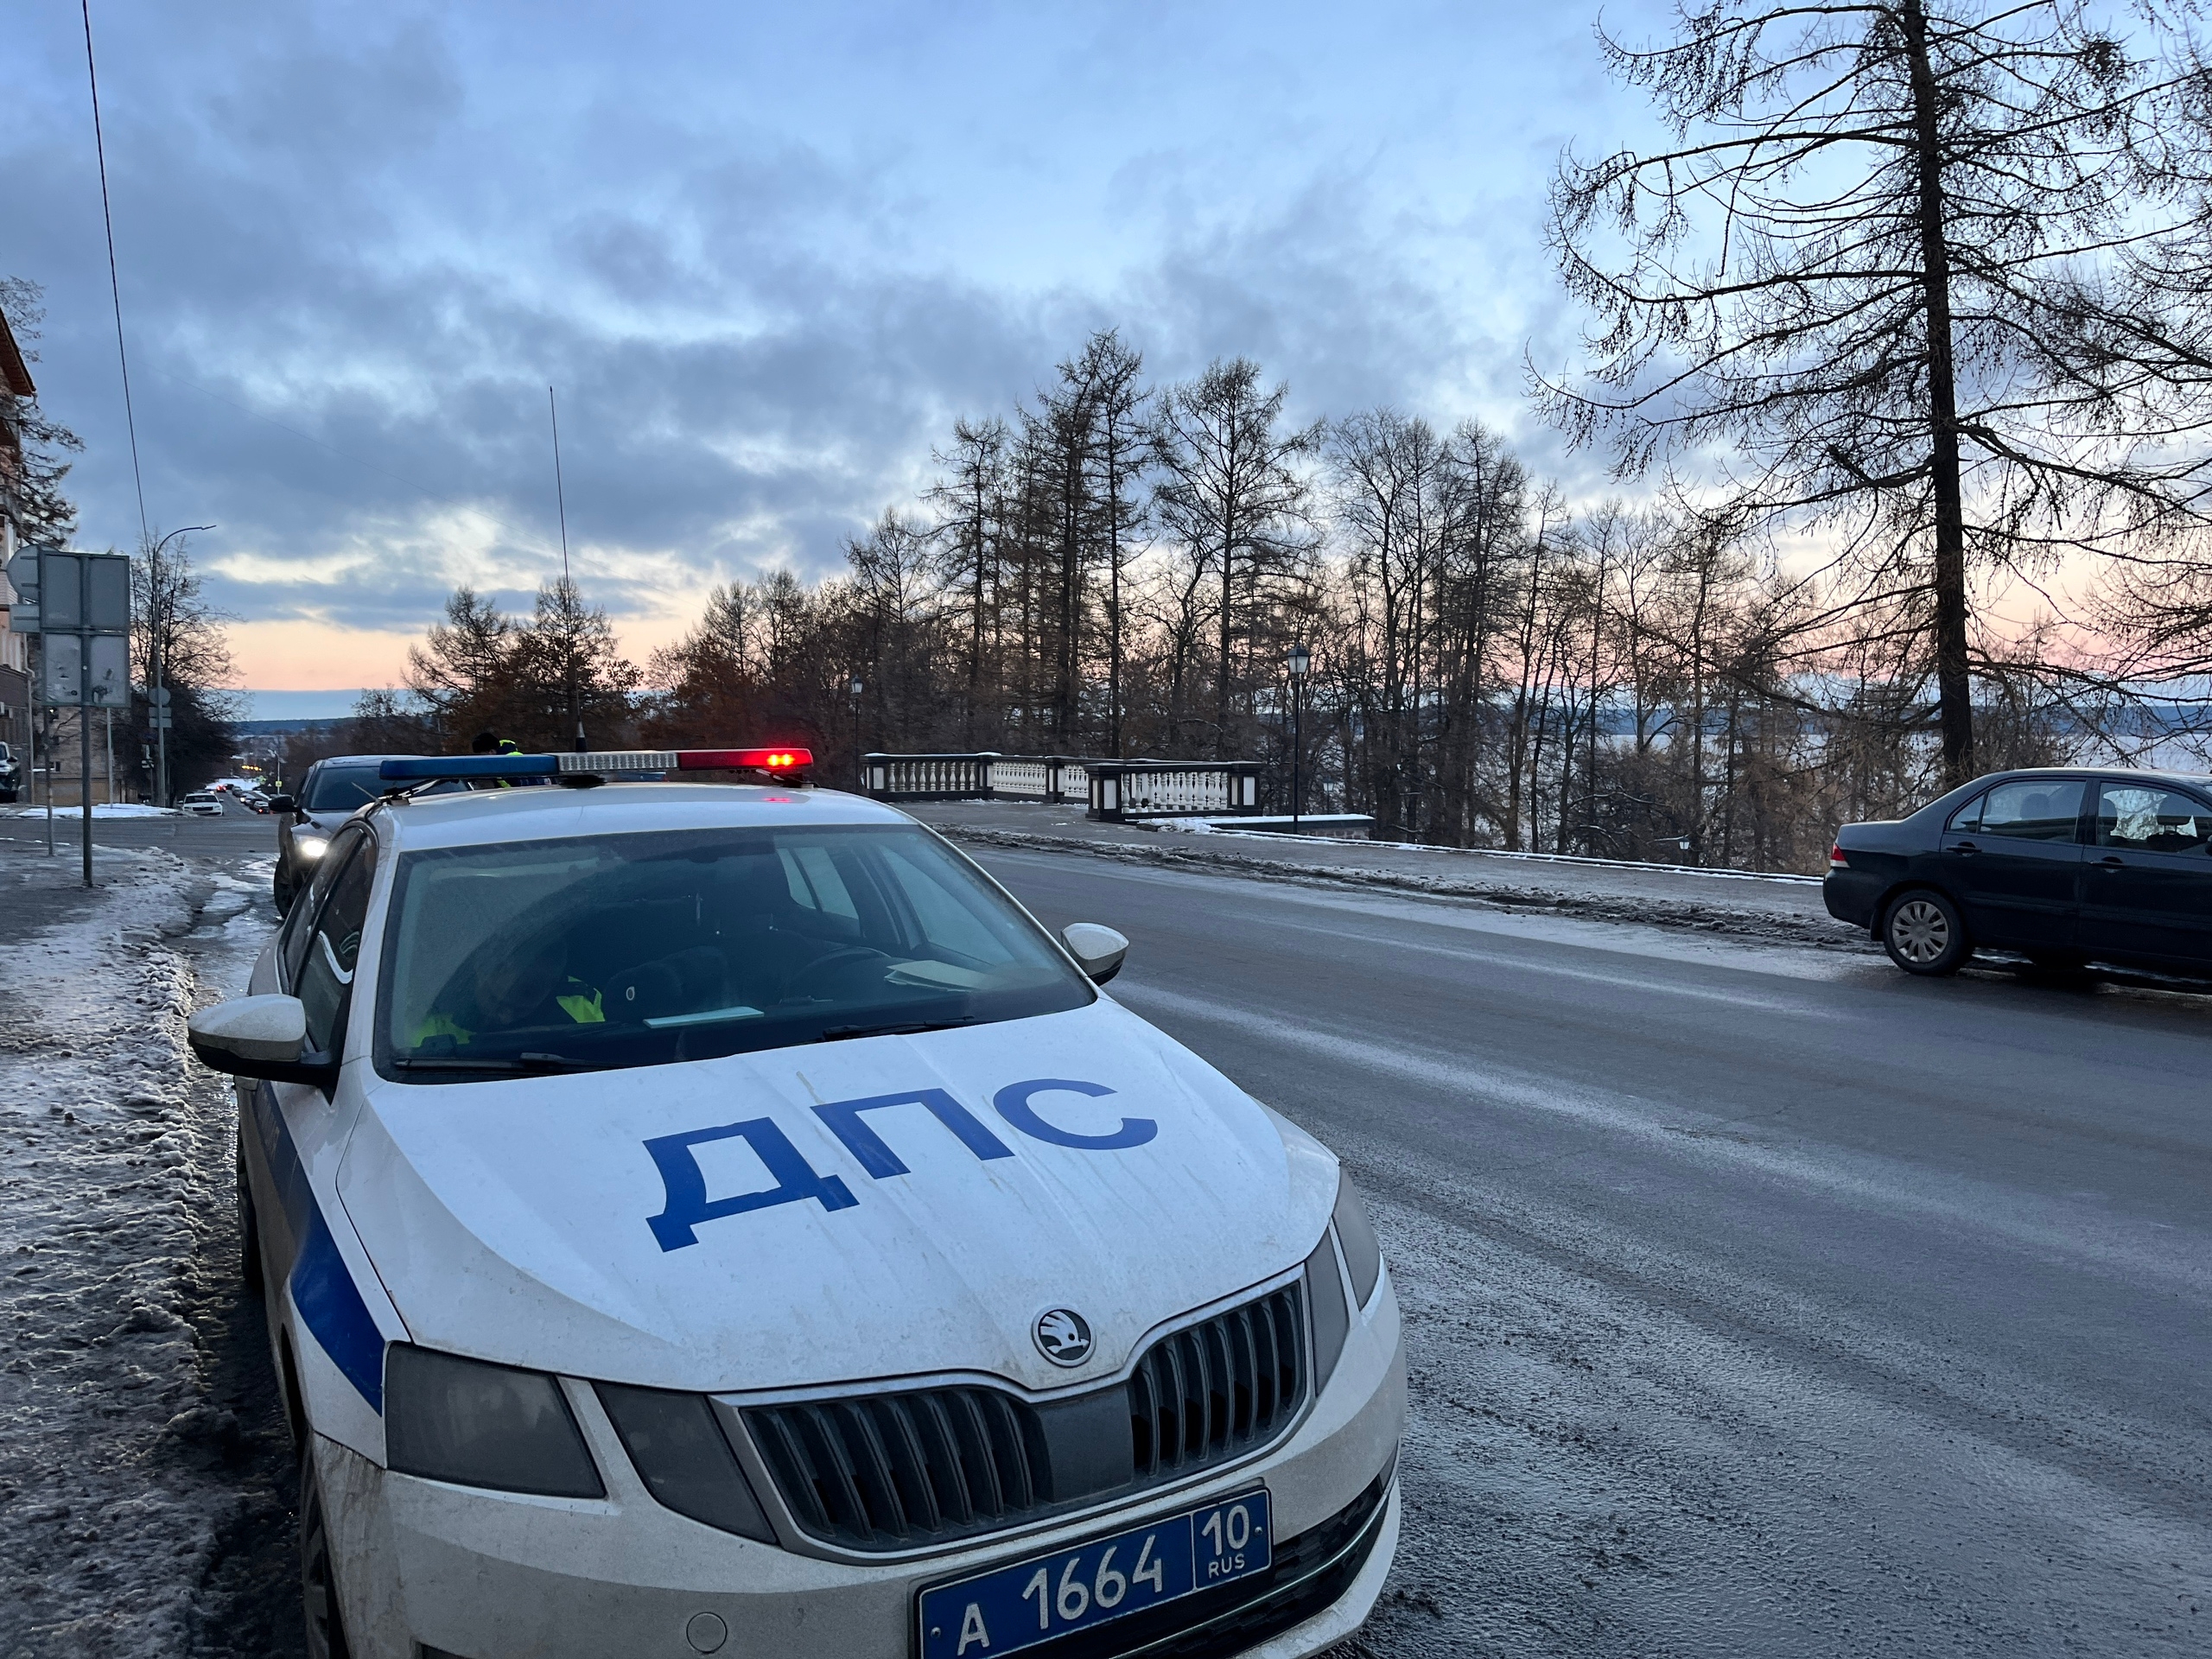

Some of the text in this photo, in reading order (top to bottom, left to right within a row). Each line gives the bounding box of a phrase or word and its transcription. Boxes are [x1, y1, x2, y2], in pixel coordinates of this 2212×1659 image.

[642, 1078, 1158, 1252] ДПС
[957, 1504, 1250, 1656] А 1664 10
[1208, 1553, 1245, 1580] RUS
